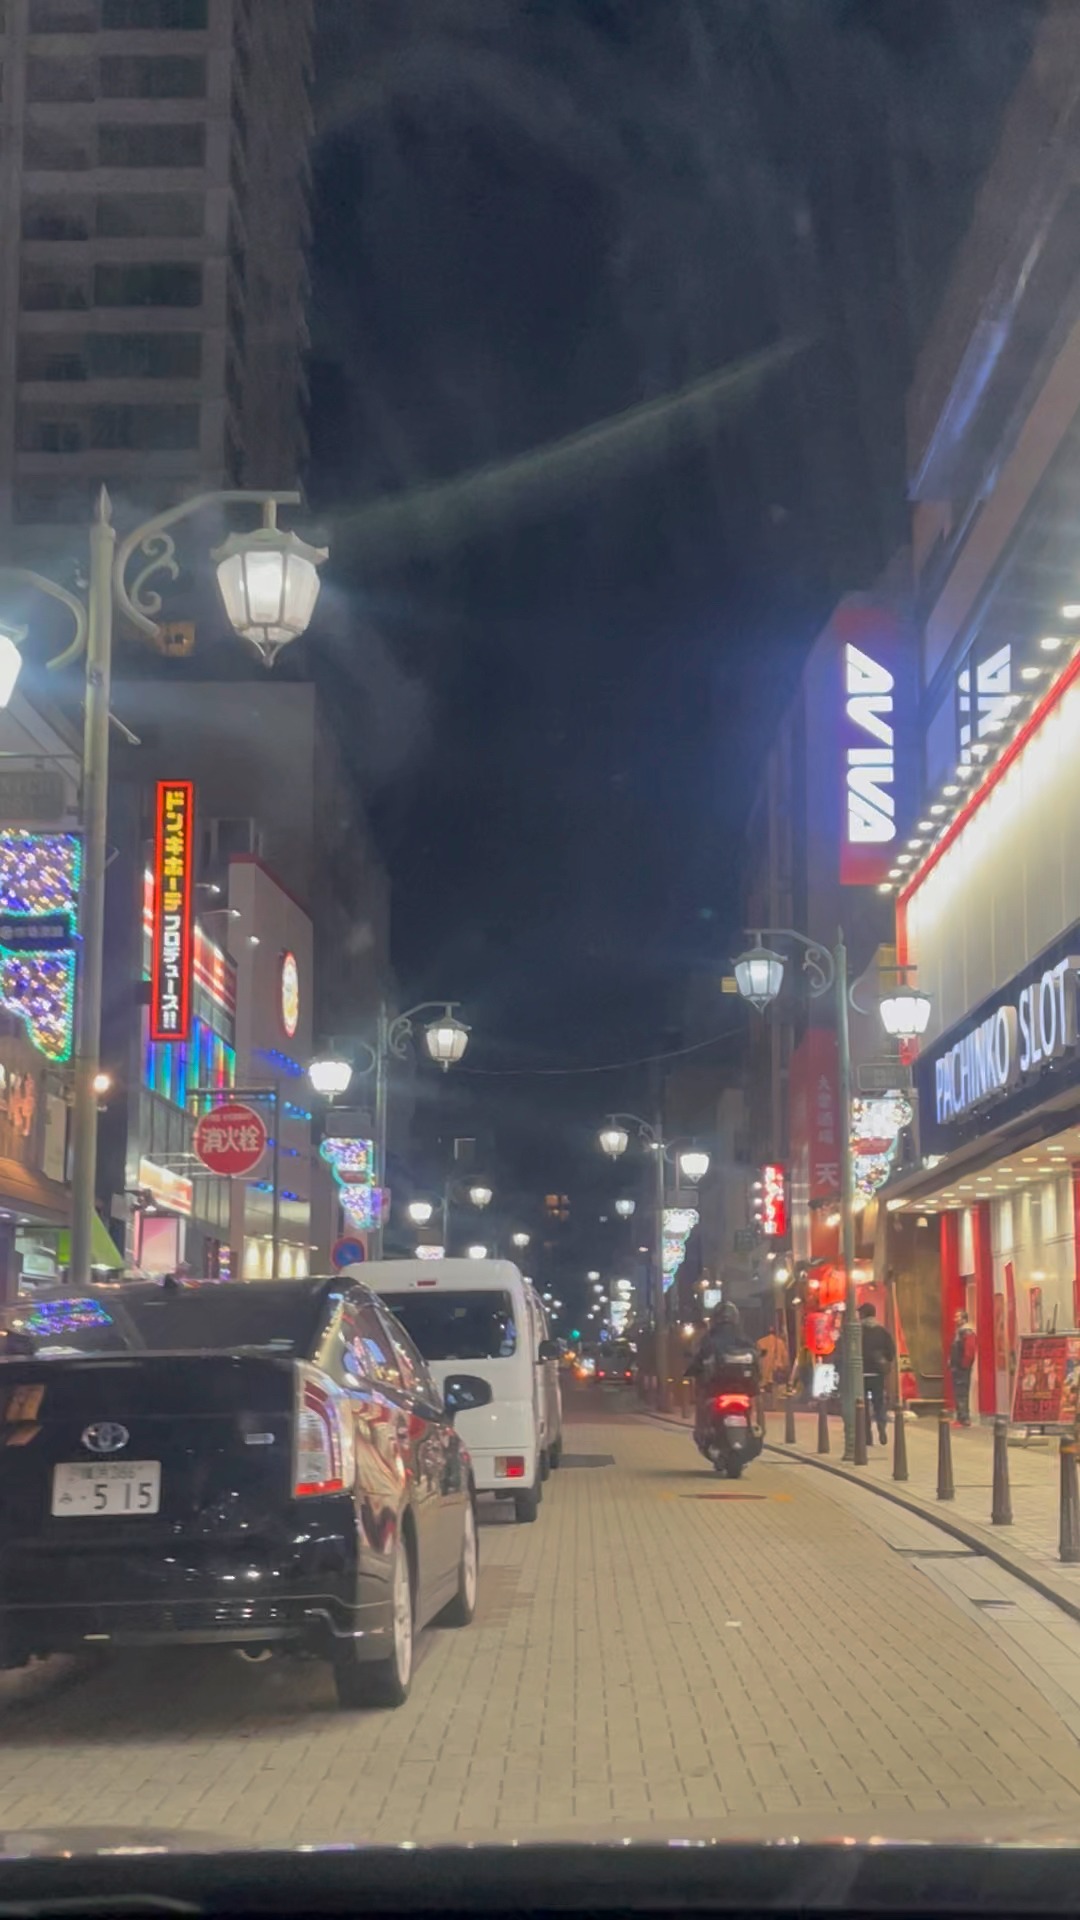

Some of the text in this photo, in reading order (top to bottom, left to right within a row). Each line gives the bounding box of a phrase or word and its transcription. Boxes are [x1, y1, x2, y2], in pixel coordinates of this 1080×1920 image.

[846, 642, 897, 842] AVIVA
[935, 957, 1070, 1125] PACHINKO SLOT
[201, 1124, 261, 1153] 消火栓
[94, 1482, 153, 1511] 515
